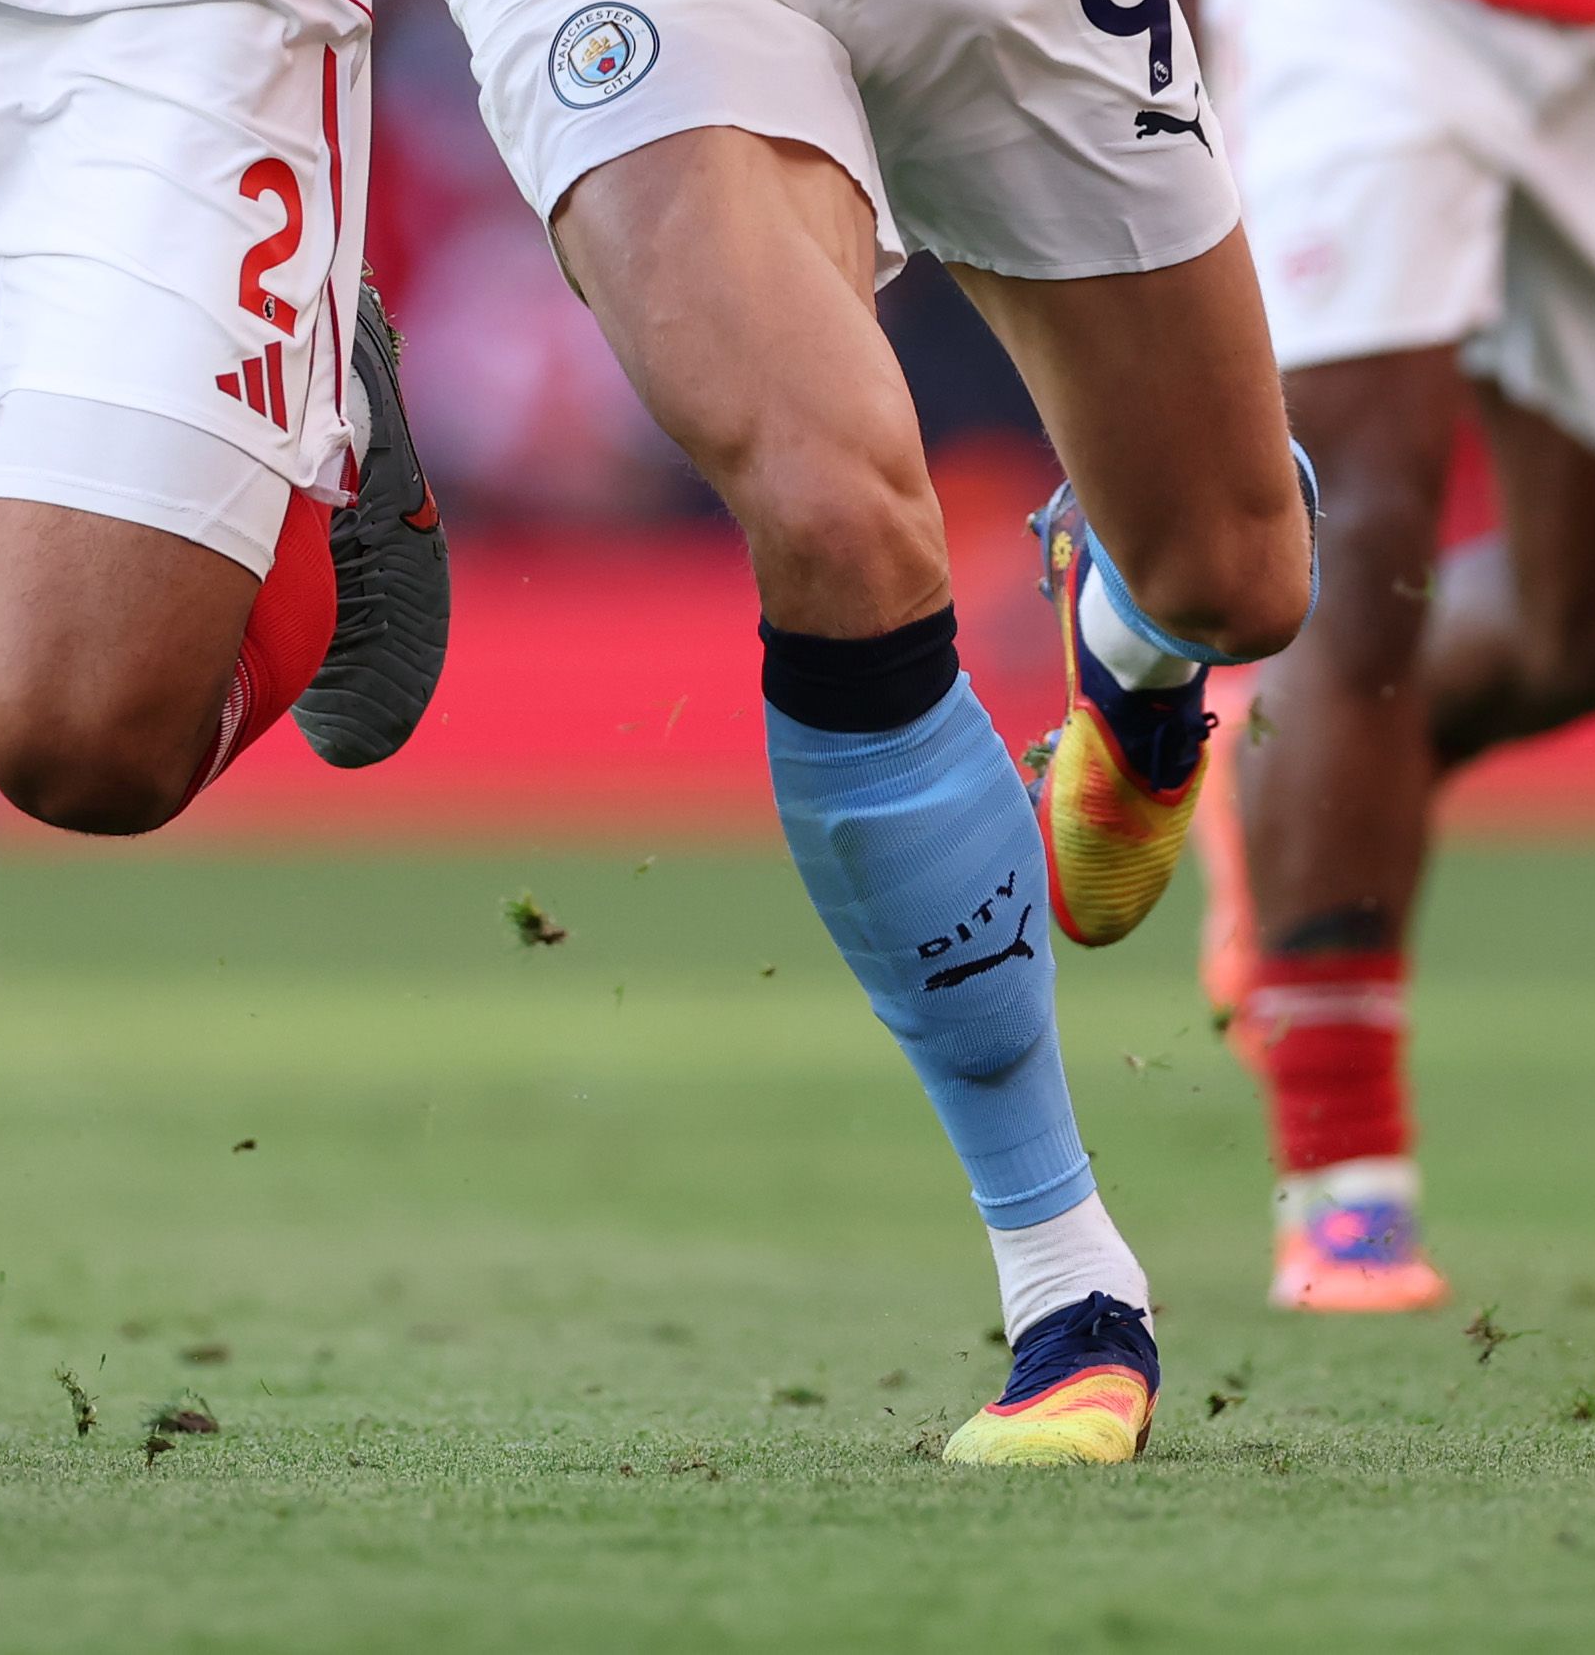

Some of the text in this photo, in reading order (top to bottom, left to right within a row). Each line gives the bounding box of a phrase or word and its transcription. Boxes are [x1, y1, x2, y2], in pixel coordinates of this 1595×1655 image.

[557, 9, 633, 72] MANCHESTER
[603, 71, 633, 95] CITY
[239, 157, 303, 338] 2
